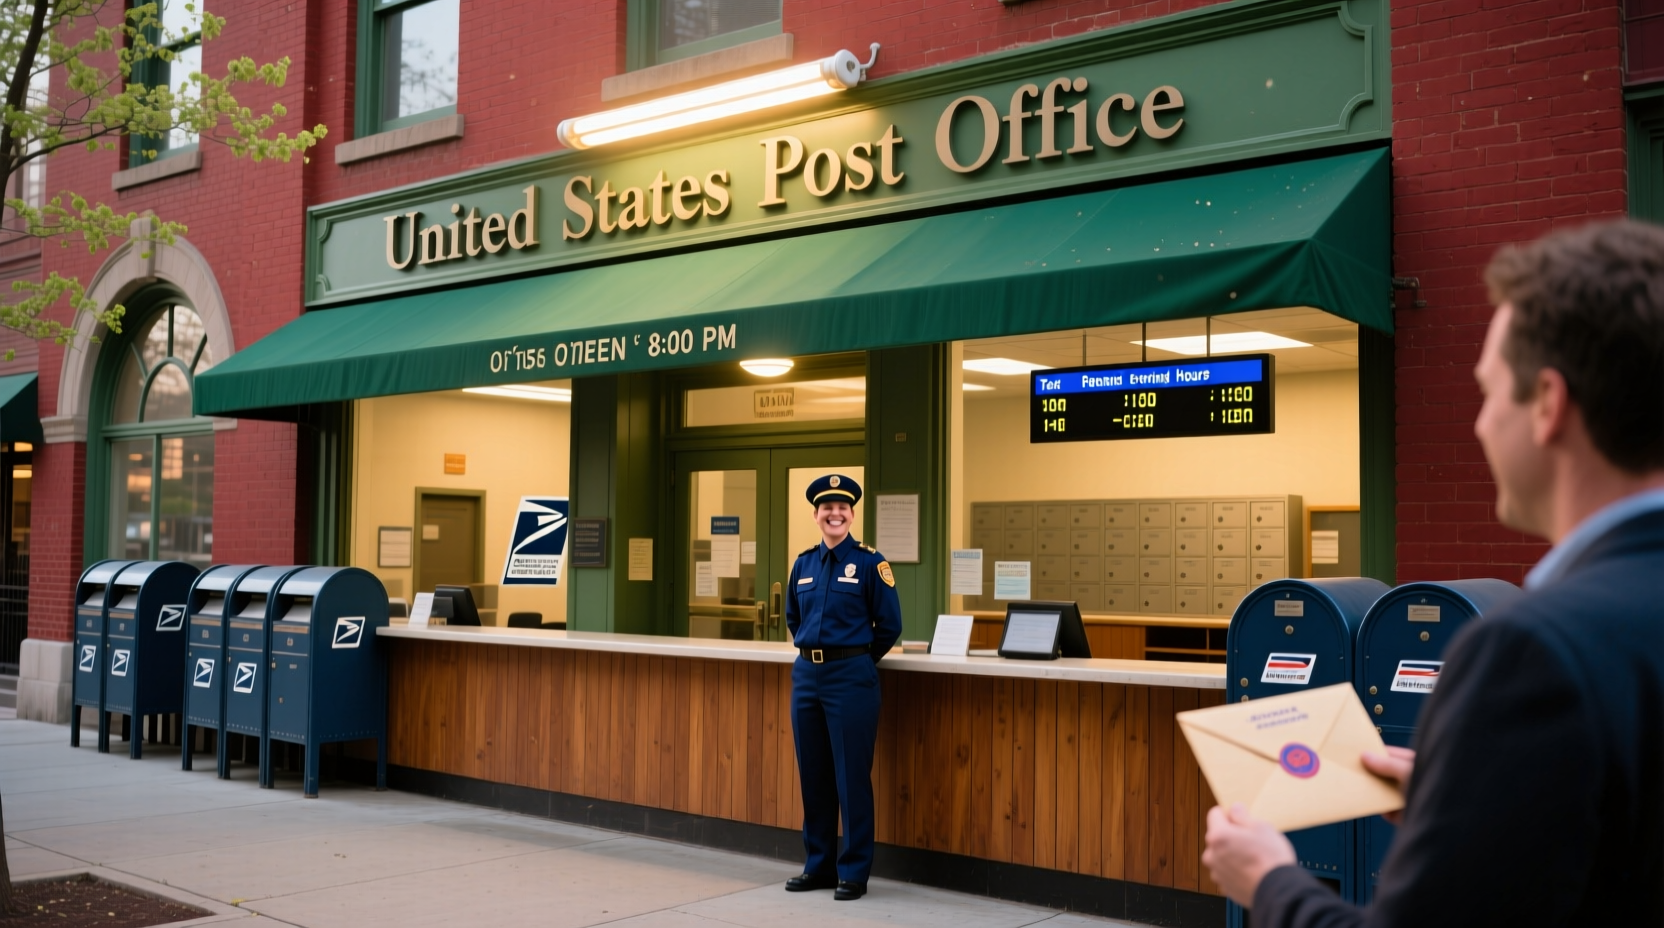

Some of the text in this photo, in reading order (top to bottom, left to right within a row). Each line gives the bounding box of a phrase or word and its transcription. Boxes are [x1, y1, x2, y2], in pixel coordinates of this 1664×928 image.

[383, 76, 1185, 270] United States Post Office
[648, 328, 694, 357] 8:00
[702, 323, 737, 351] PM
[1176, 368, 1210, 382] Hours
